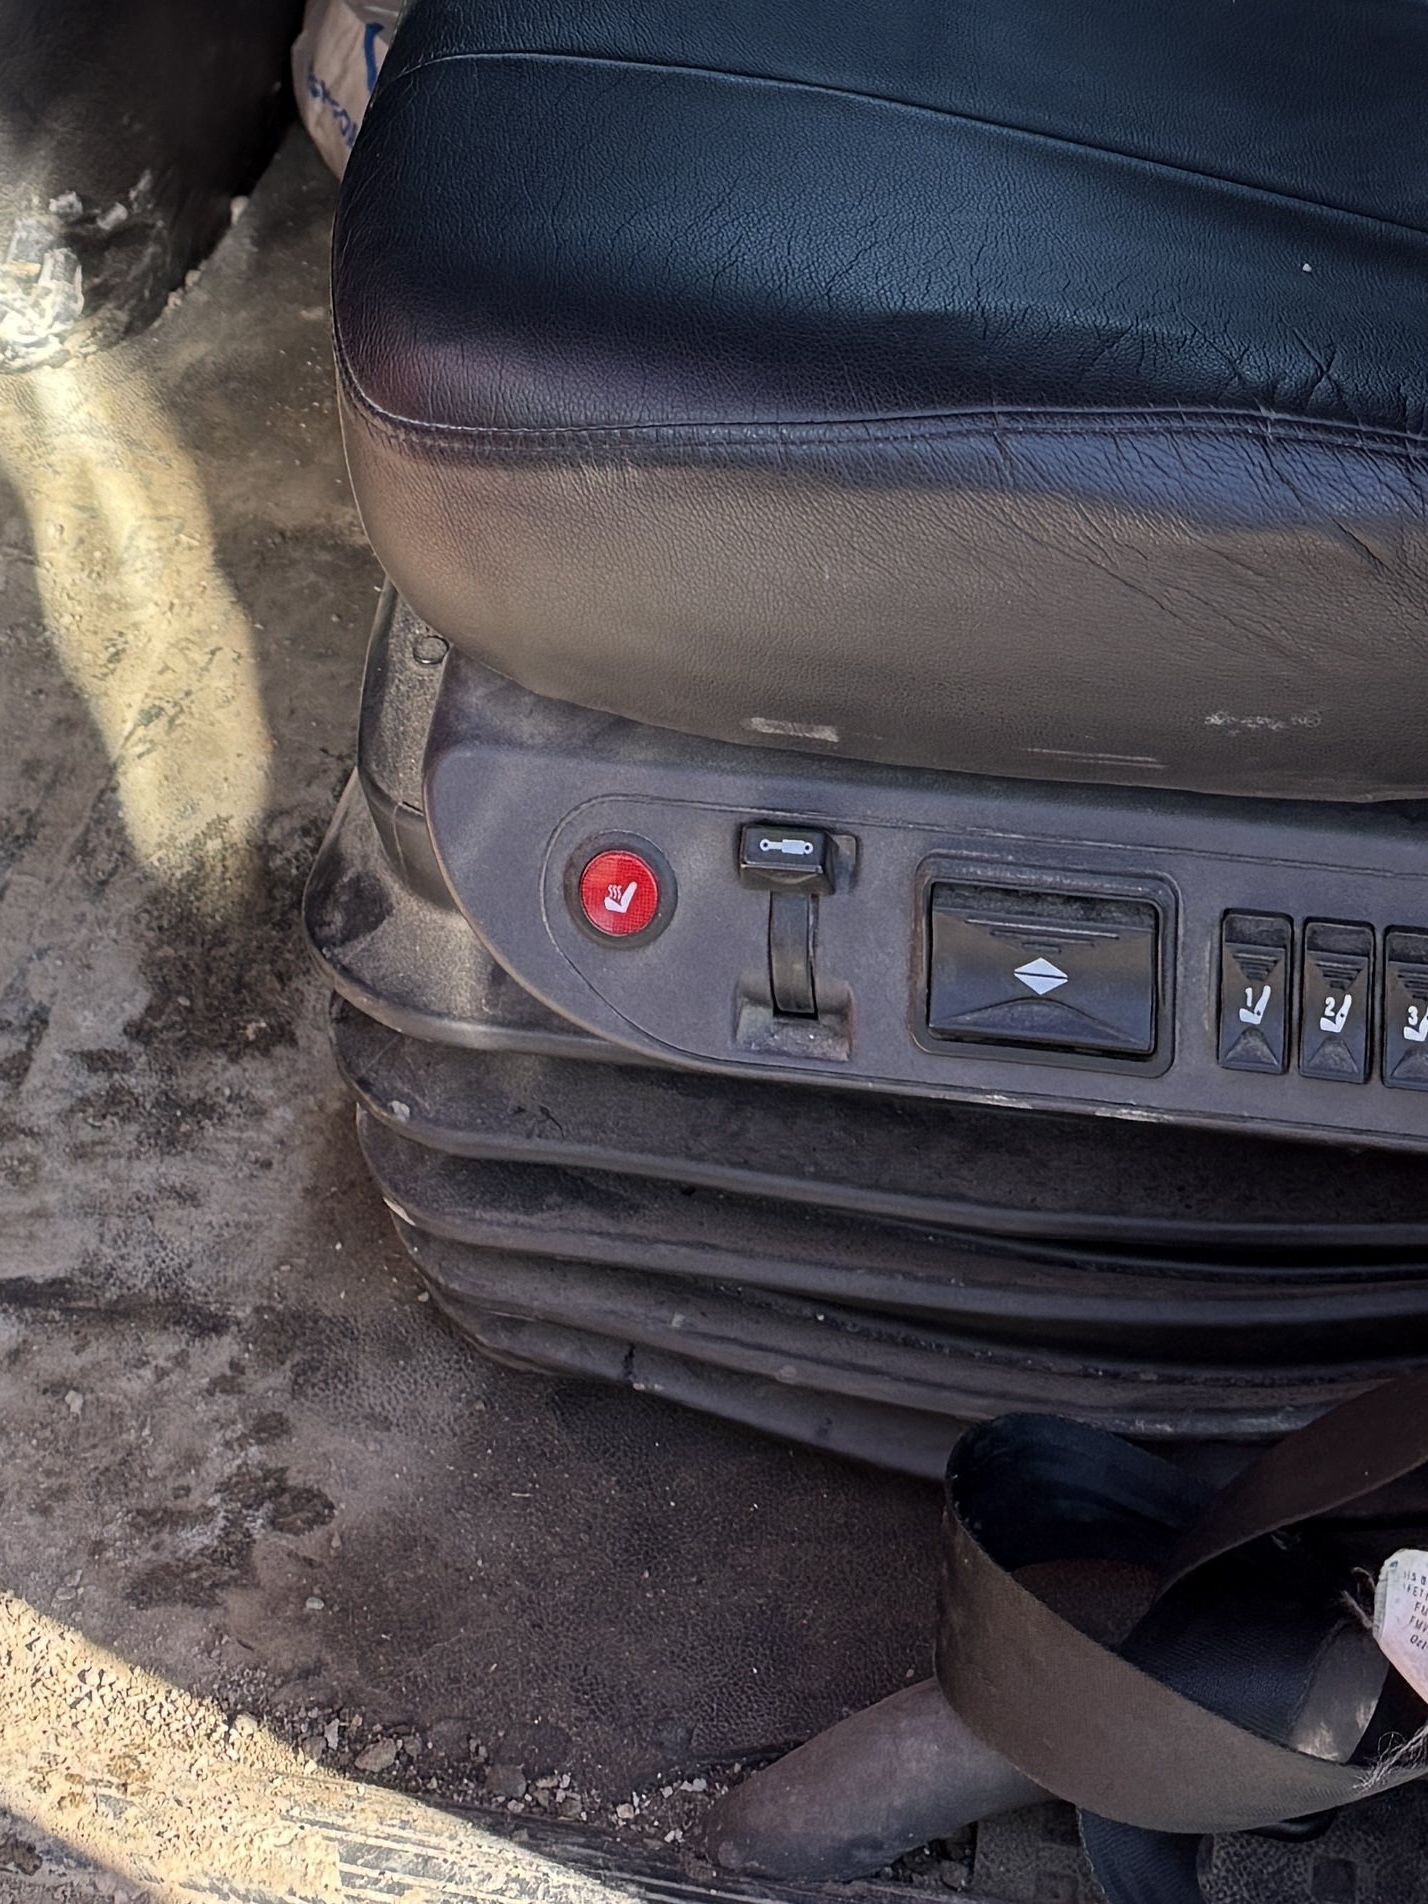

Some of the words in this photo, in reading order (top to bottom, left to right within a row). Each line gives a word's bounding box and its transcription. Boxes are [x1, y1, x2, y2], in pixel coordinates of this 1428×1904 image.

[1245, 987, 1253, 1007] 1
[1324, 996, 1336, 1017] 2
[1407, 1005, 1419, 1026] 3
